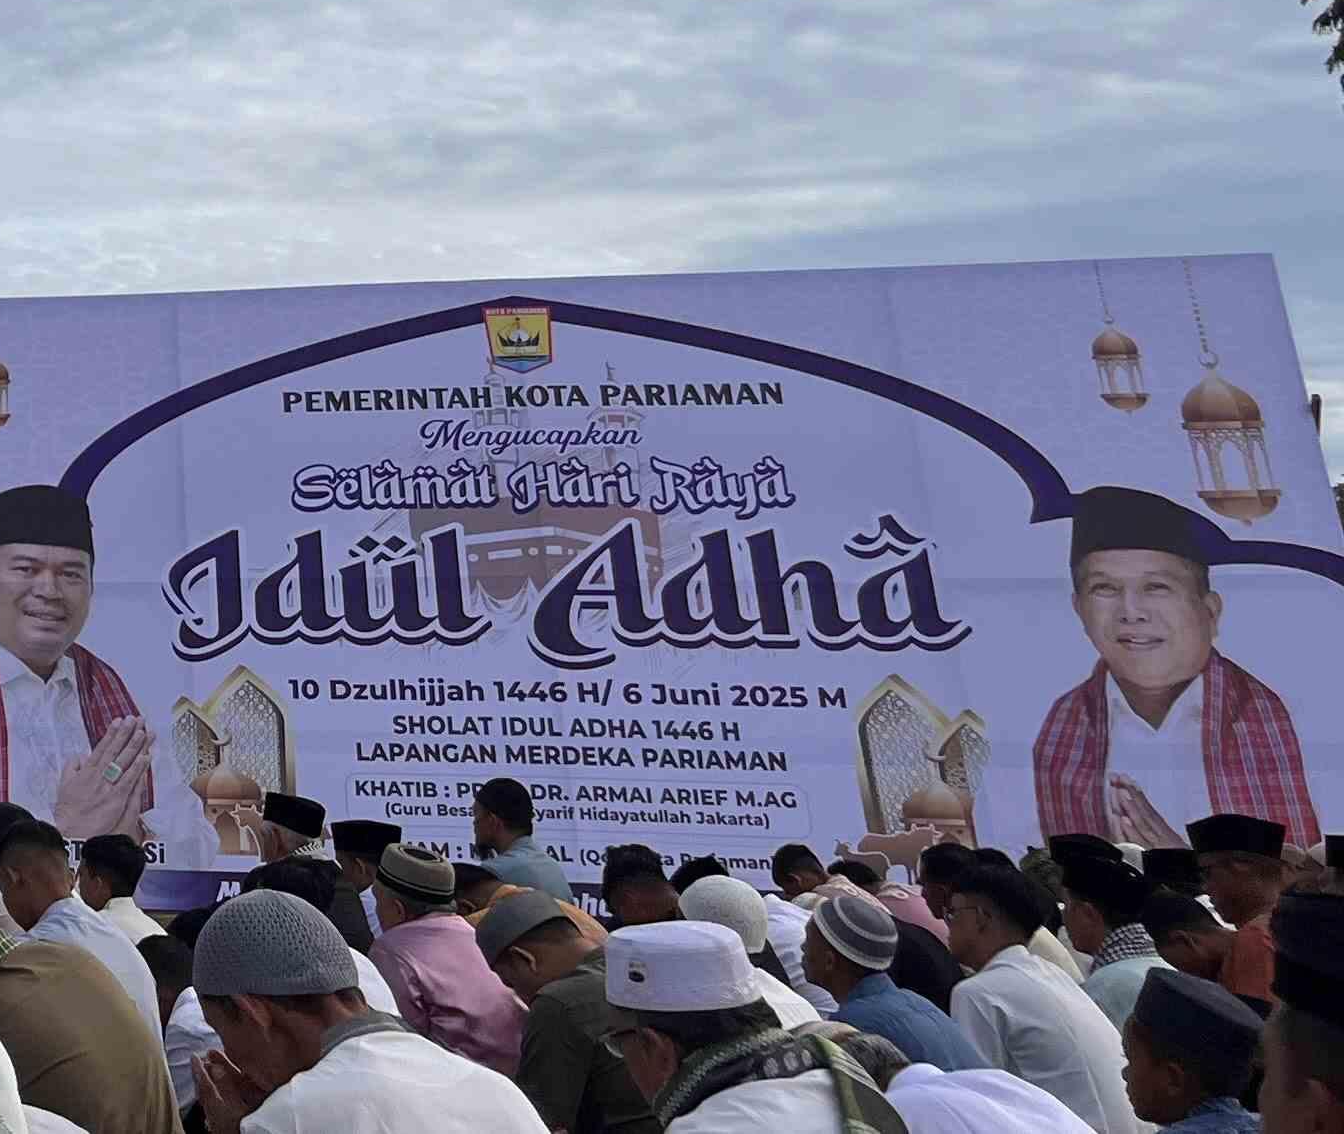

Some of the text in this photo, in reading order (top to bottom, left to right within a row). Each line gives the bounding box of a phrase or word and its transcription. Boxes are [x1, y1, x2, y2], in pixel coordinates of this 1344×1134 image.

[282, 382, 784, 413] PEMERINTAH KOTA PARIAMAN
[419, 419, 642, 454] Mengucapkan
[288, 679, 319, 700] 10
[330, 678, 484, 707] Dzulhijjah
[493, 681, 568, 703] 1446
[623, 682, 642, 704] 6
[651, 683, 721, 706] Juni
[731, 685, 809, 708] 2025
[819, 686, 848, 709] M
[393, 715, 740, 742] SHOLAT IDUL ADHA 1446 H
[356, 742, 788, 772] LAPANGAN MERDEKA PARIAMAN
[355, 780, 438, 798] KHATIB
[531, 784, 569, 802] DR.
[575, 785, 653, 804] ARMAI
[659, 788, 728, 807] ARIEF
[735, 789, 798, 809] M.AG
[385, 802, 432, 819] (Guru
[579, 807, 691, 825] Hidayatullah
[696, 811, 769, 829] Jakarta)
